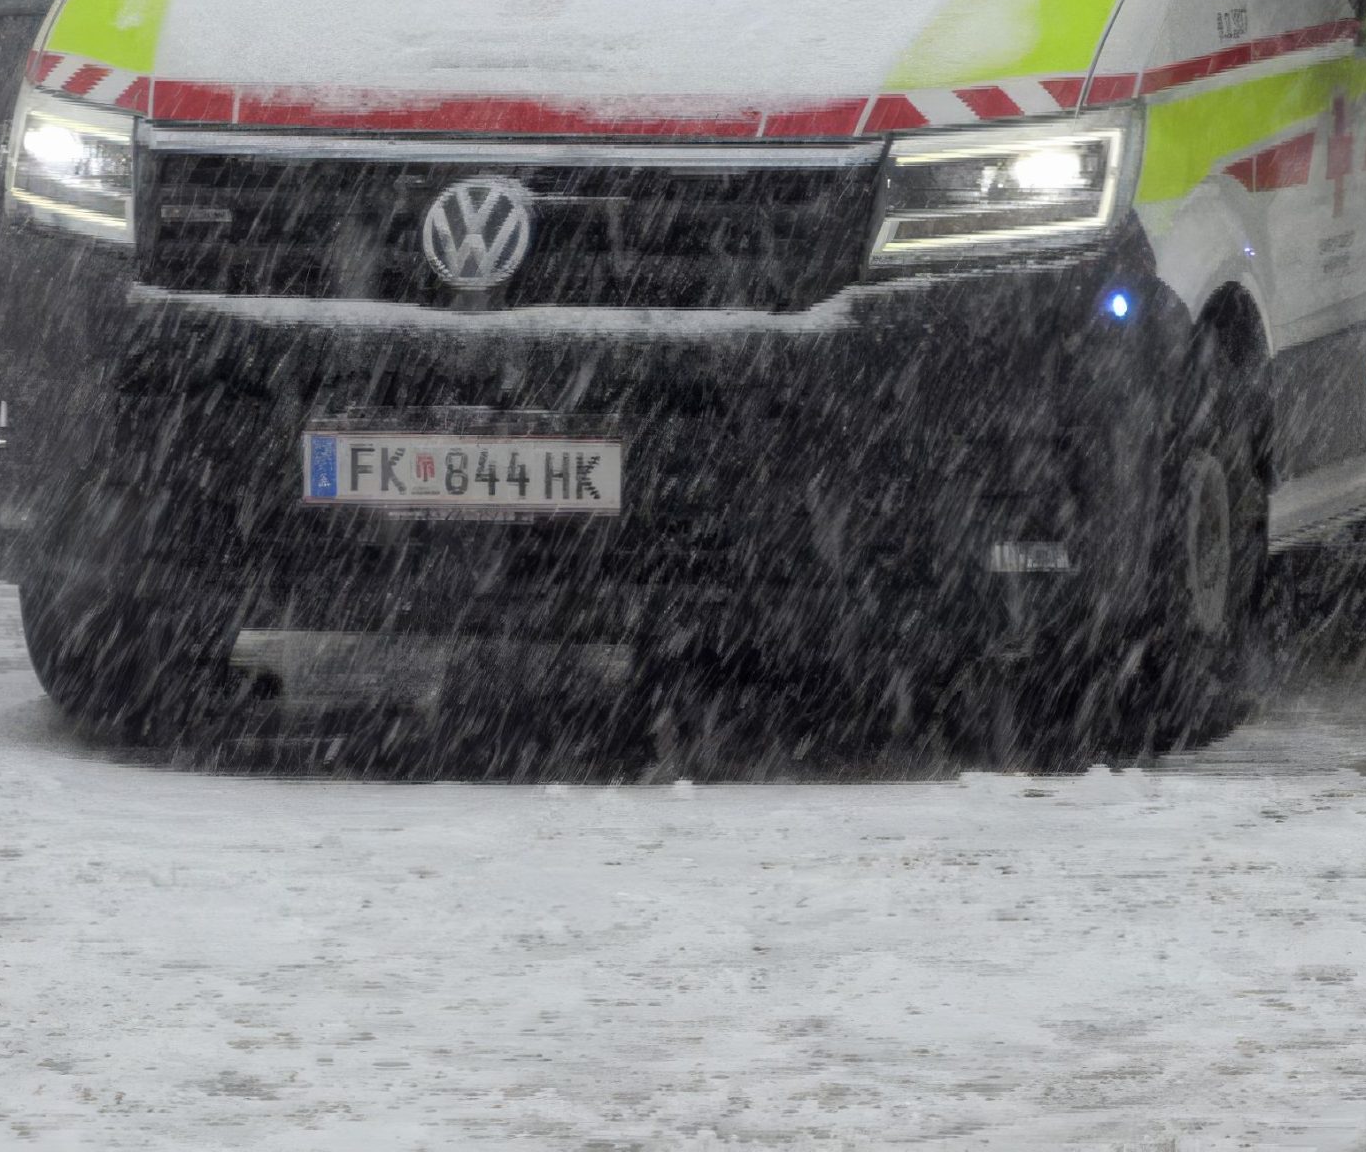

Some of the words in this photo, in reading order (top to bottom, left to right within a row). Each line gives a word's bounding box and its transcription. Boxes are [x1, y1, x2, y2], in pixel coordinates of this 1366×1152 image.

[349, 446, 407, 495] FK
[445, 448, 530, 497] 844
[545, 452, 601, 500] HK
